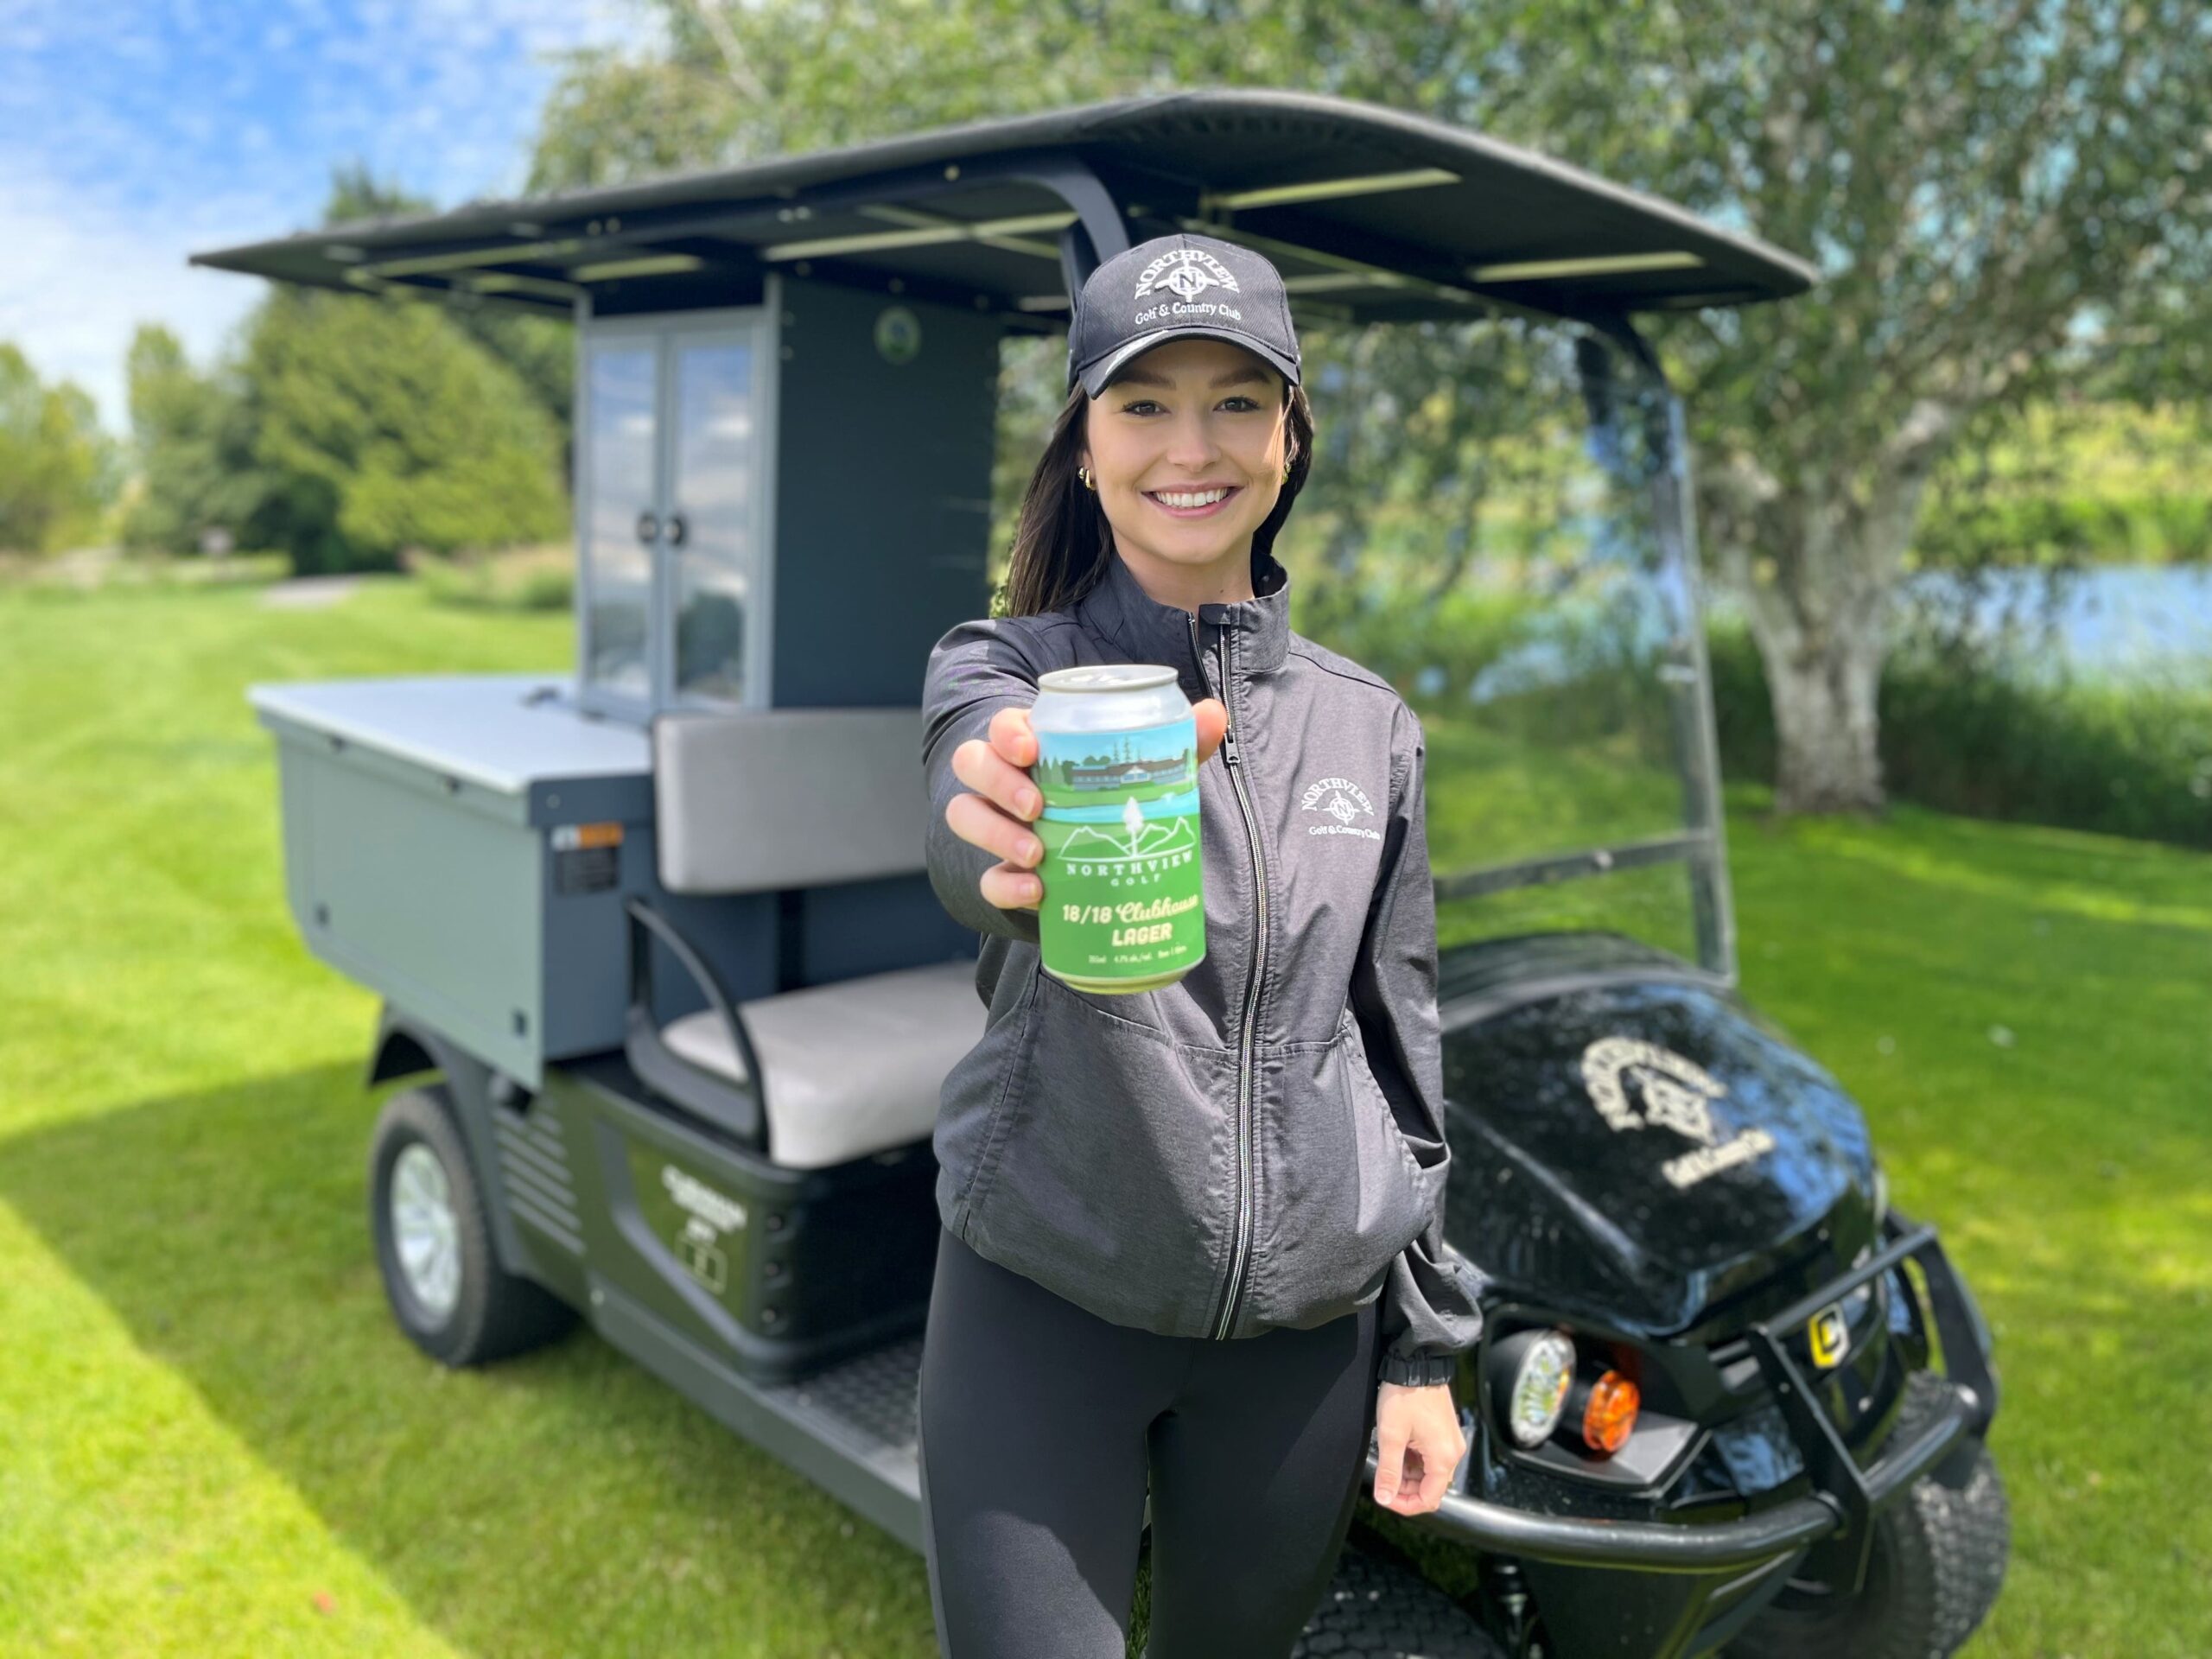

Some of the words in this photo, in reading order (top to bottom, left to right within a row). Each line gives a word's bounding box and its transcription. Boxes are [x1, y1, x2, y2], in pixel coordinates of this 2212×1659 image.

[1135, 249, 1240, 300] NORTHVIEW
[1135, 307, 1157, 325] Golf
[1159, 304, 1170, 316] &
[1172, 302, 1217, 315] Country
[1218, 303, 1242, 321] Club
[1301, 778, 1375, 816] NORTHVIEW
[1067, 850, 1192, 875] NORTHVIEW
[1110, 874, 1160, 887] GOLF
[1063, 904, 1113, 925] 18/18
[1111, 922, 1173, 946] LAGER
